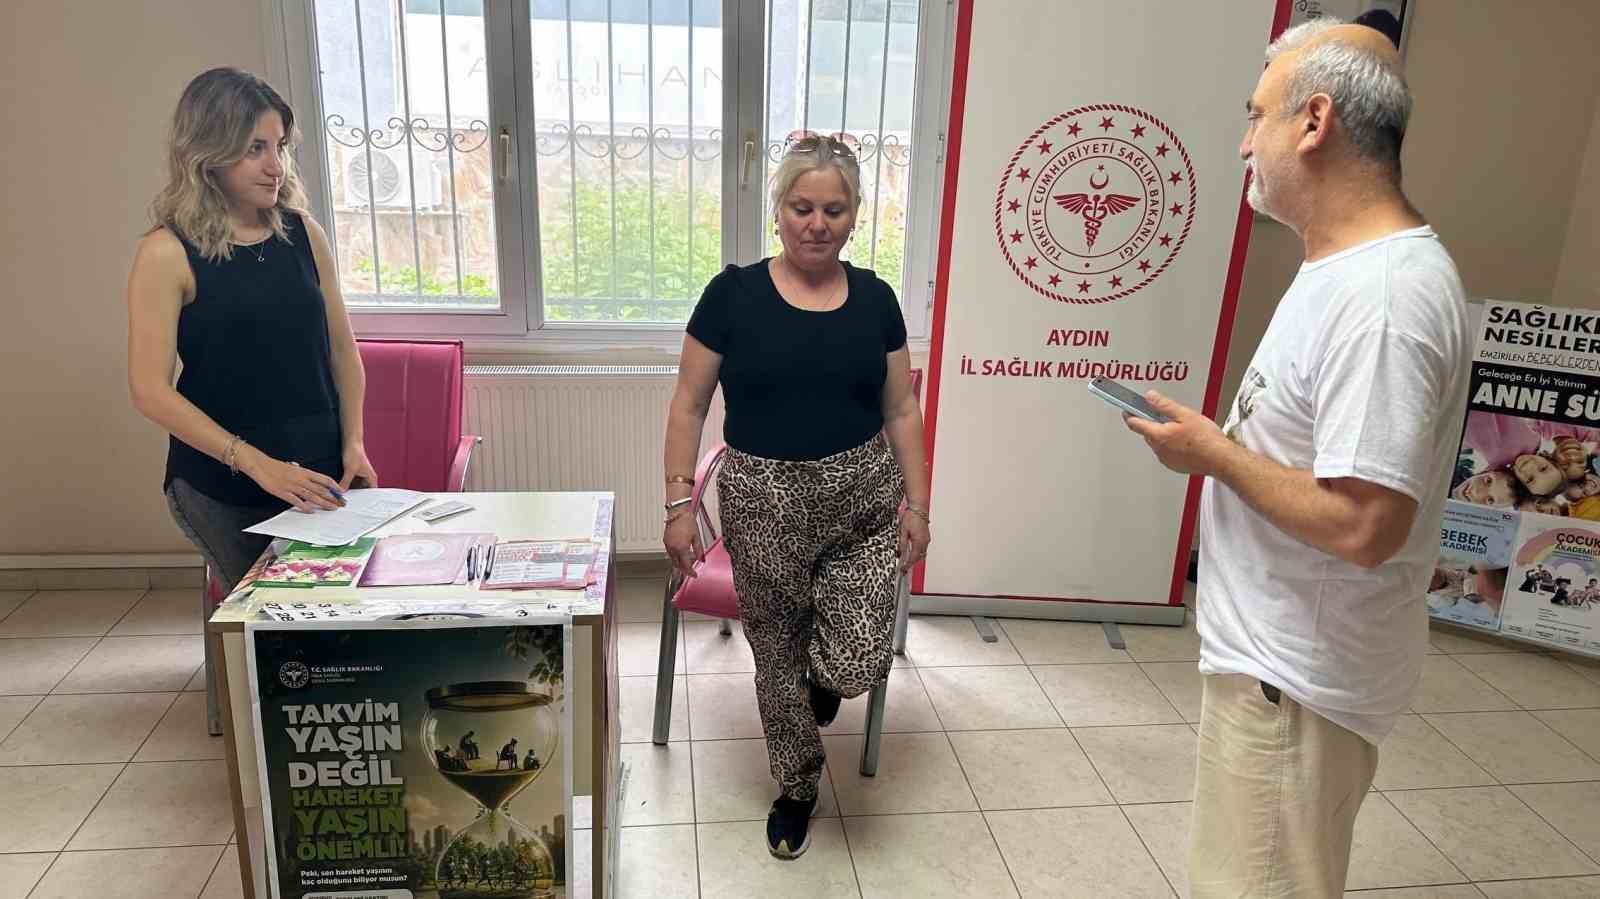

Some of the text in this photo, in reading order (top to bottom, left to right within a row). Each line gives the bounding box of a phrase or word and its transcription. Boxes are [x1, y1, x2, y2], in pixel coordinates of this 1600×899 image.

[1032, 142, 1160, 261] TÜRKİYE CUMHURİYETİ SAĞLIK BAKANLIĞI
[1047, 329, 1109, 347] AYDIN
[960, 355, 1189, 381] İL SAĞLIK MÜDÜRLÜĞÜ
[1478, 368, 1586, 389] Geleceğe En İyi Yatırım
[1472, 382, 1558, 414] ANNE
[1440, 529, 1488, 547] BEBEK
[1556, 532, 1600, 548] ÇOCUK
[282, 698, 399, 724] TAKVİM
[285, 725, 402, 757] YAŞIN
[288, 752, 403, 787] DEĞİL
[292, 786, 403, 807] HAREKET
[296, 806, 406, 839] YAŞIN
[297, 833, 407, 861] ÖNEMLİ!
